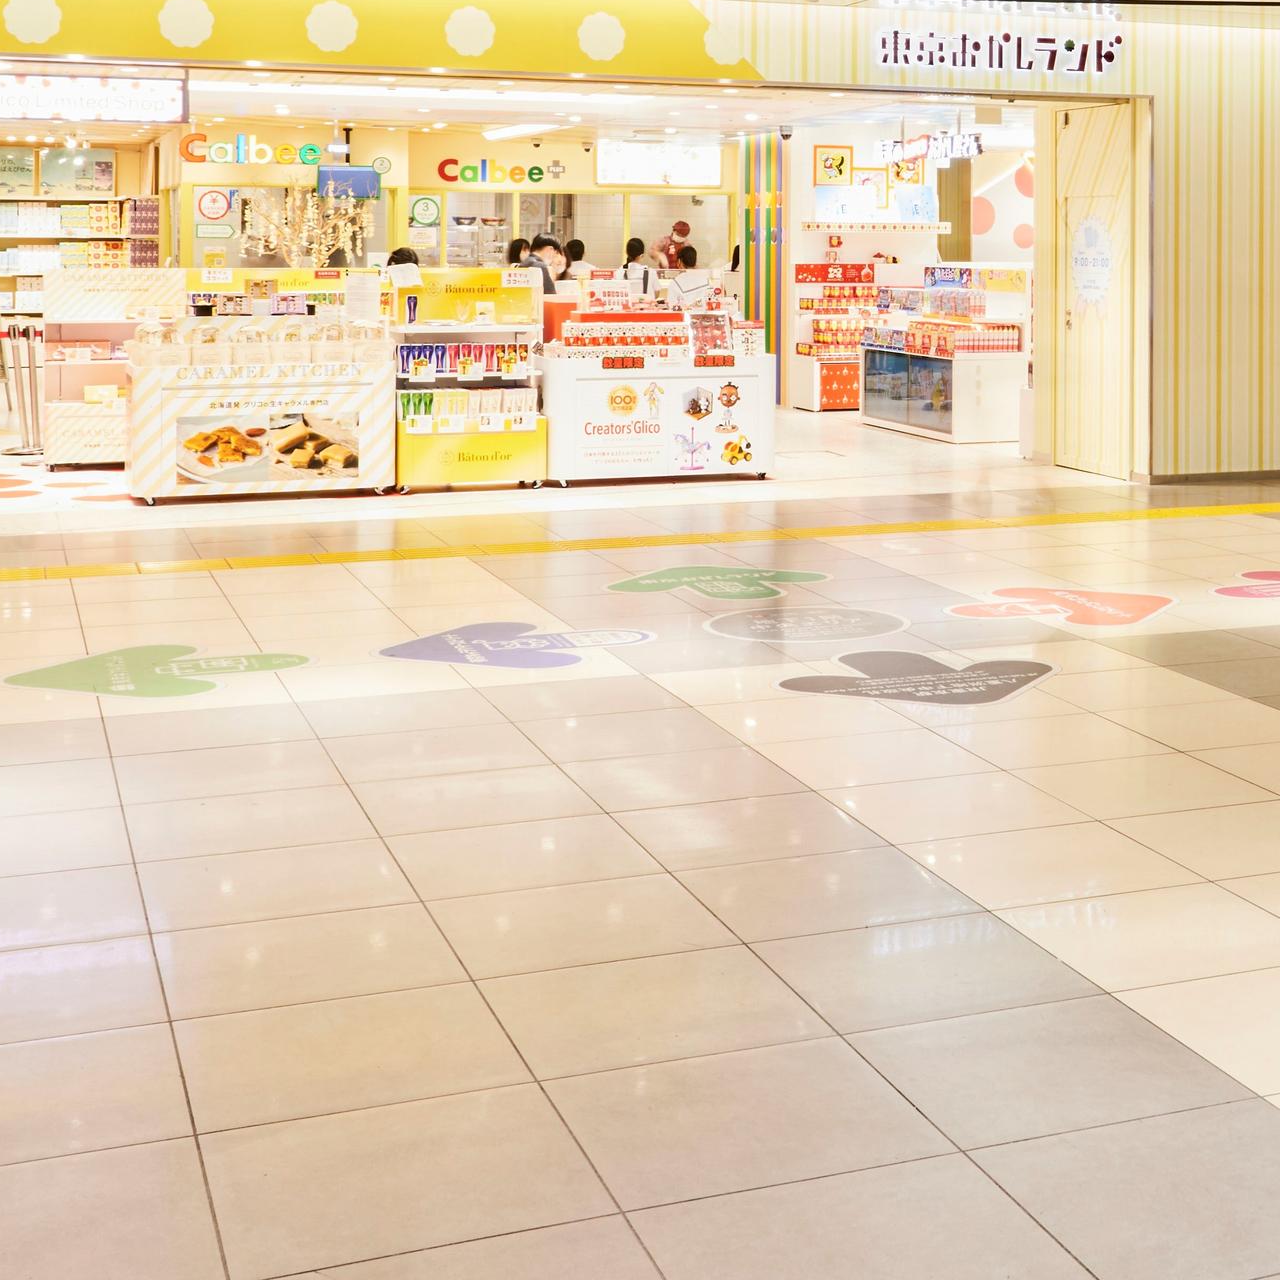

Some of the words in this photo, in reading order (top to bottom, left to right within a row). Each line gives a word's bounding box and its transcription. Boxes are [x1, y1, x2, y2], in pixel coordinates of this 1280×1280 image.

[881, 30, 1123, 73] 東京おかしランド
[179, 133, 322, 164] Calbee
[437, 158, 544, 183] Calbee
[176, 365, 271, 381] CARAMEL
[277, 363, 363, 378] KITCHEN
